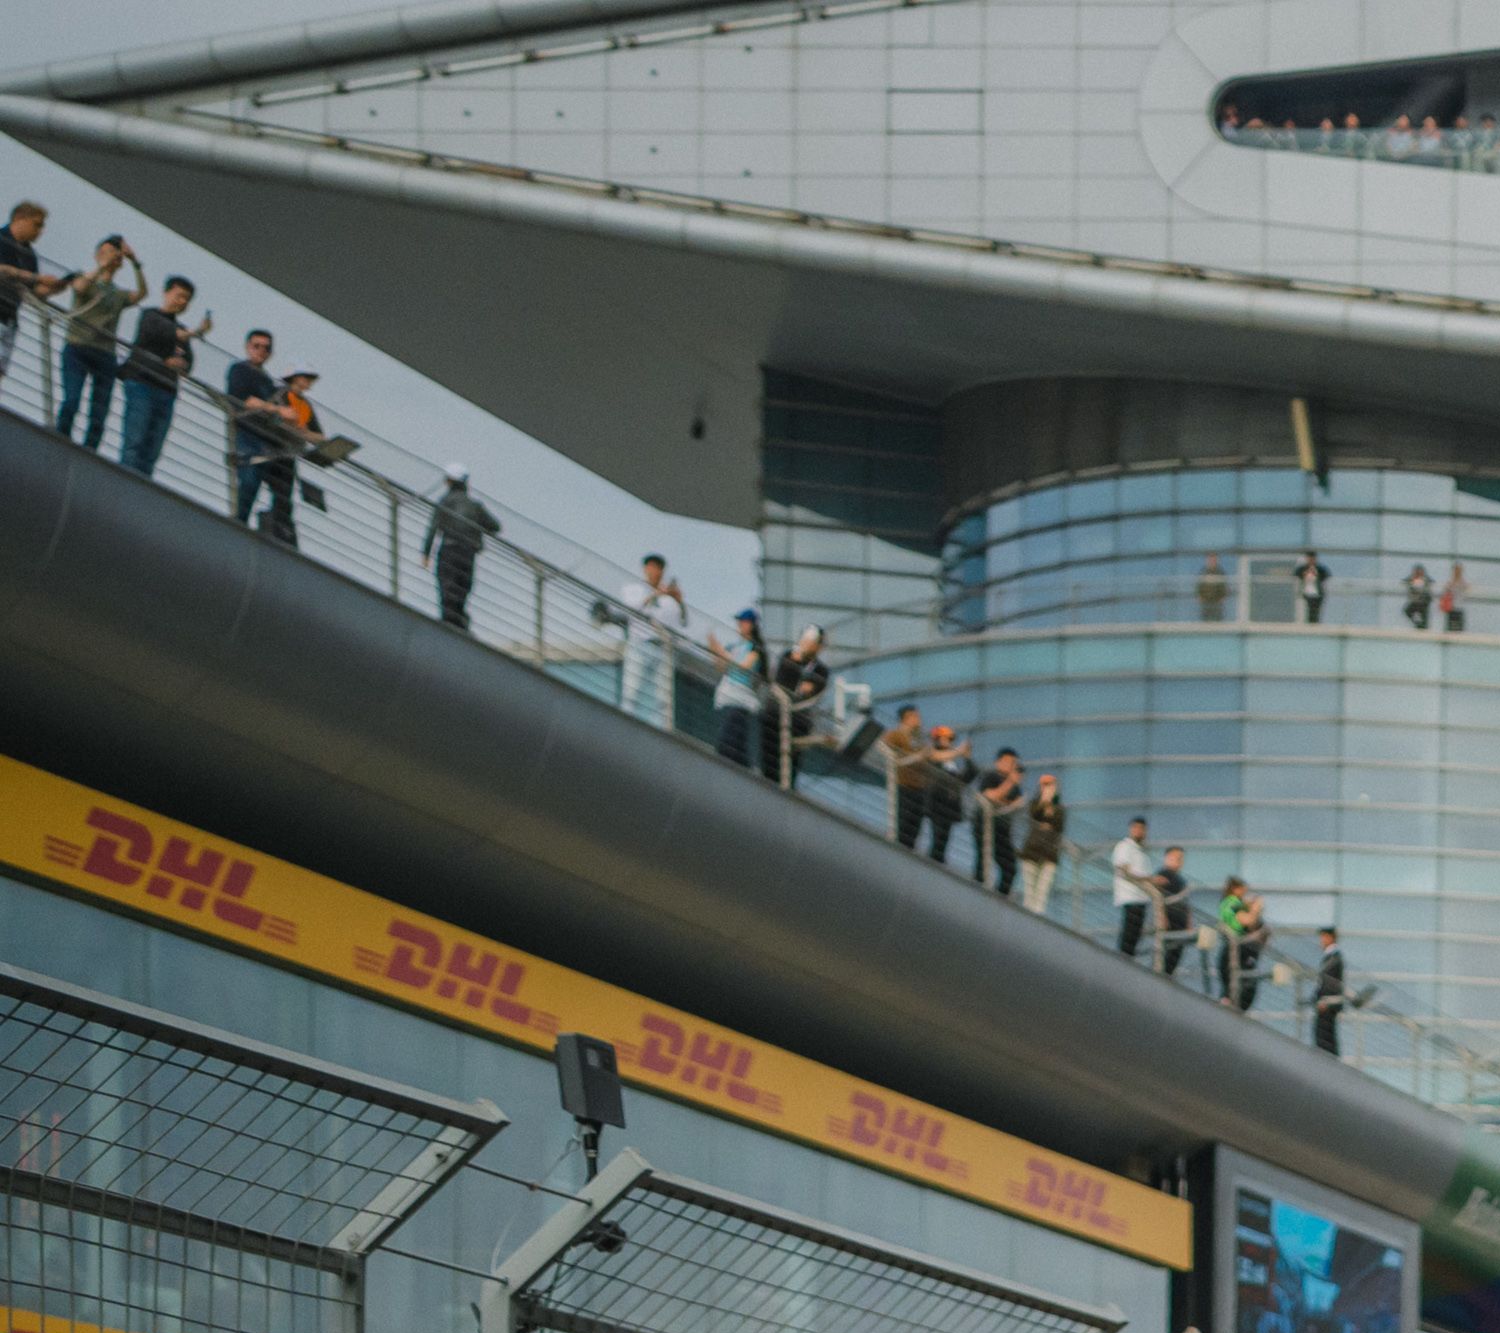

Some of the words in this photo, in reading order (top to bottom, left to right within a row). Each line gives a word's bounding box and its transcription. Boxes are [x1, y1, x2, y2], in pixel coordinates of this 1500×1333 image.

[86, 807, 272, 930] DHL
[387, 918, 534, 1024] DHL
[639, 1015, 758, 1103] DHL
[849, 1093, 952, 1169] DHL
[1025, 1159, 1113, 1234] DHL
